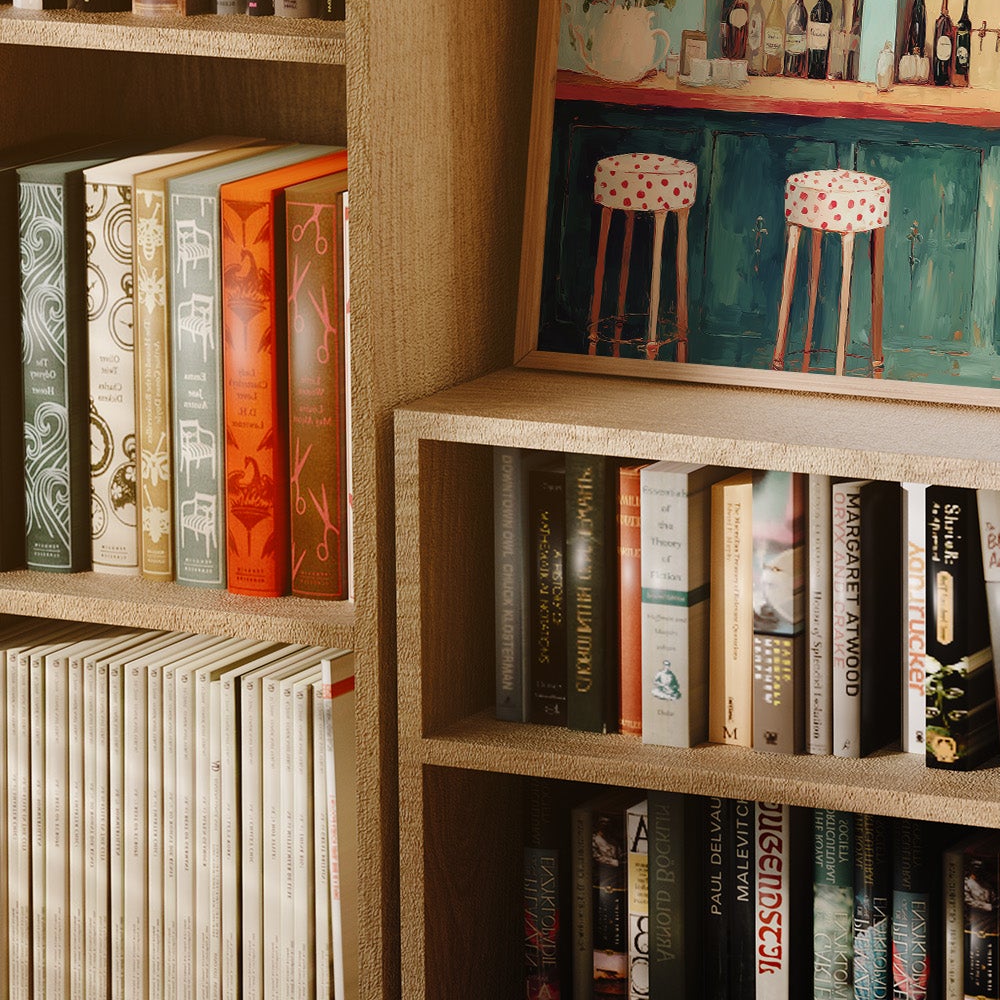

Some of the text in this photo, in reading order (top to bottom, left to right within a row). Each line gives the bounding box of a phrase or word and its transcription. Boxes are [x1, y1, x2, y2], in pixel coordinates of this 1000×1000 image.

[502, 530, 514, 558] OWL
[834, 492, 846, 544] ORYX
[502, 563, 514, 607] CHUCK
[846, 493, 861, 698] MARGARET ATWOOD
[502, 609, 514, 691] KLOSTERMAN
[834, 603, 846, 670] CRAKE
[711, 798, 722, 915] PAUL DELVAU
